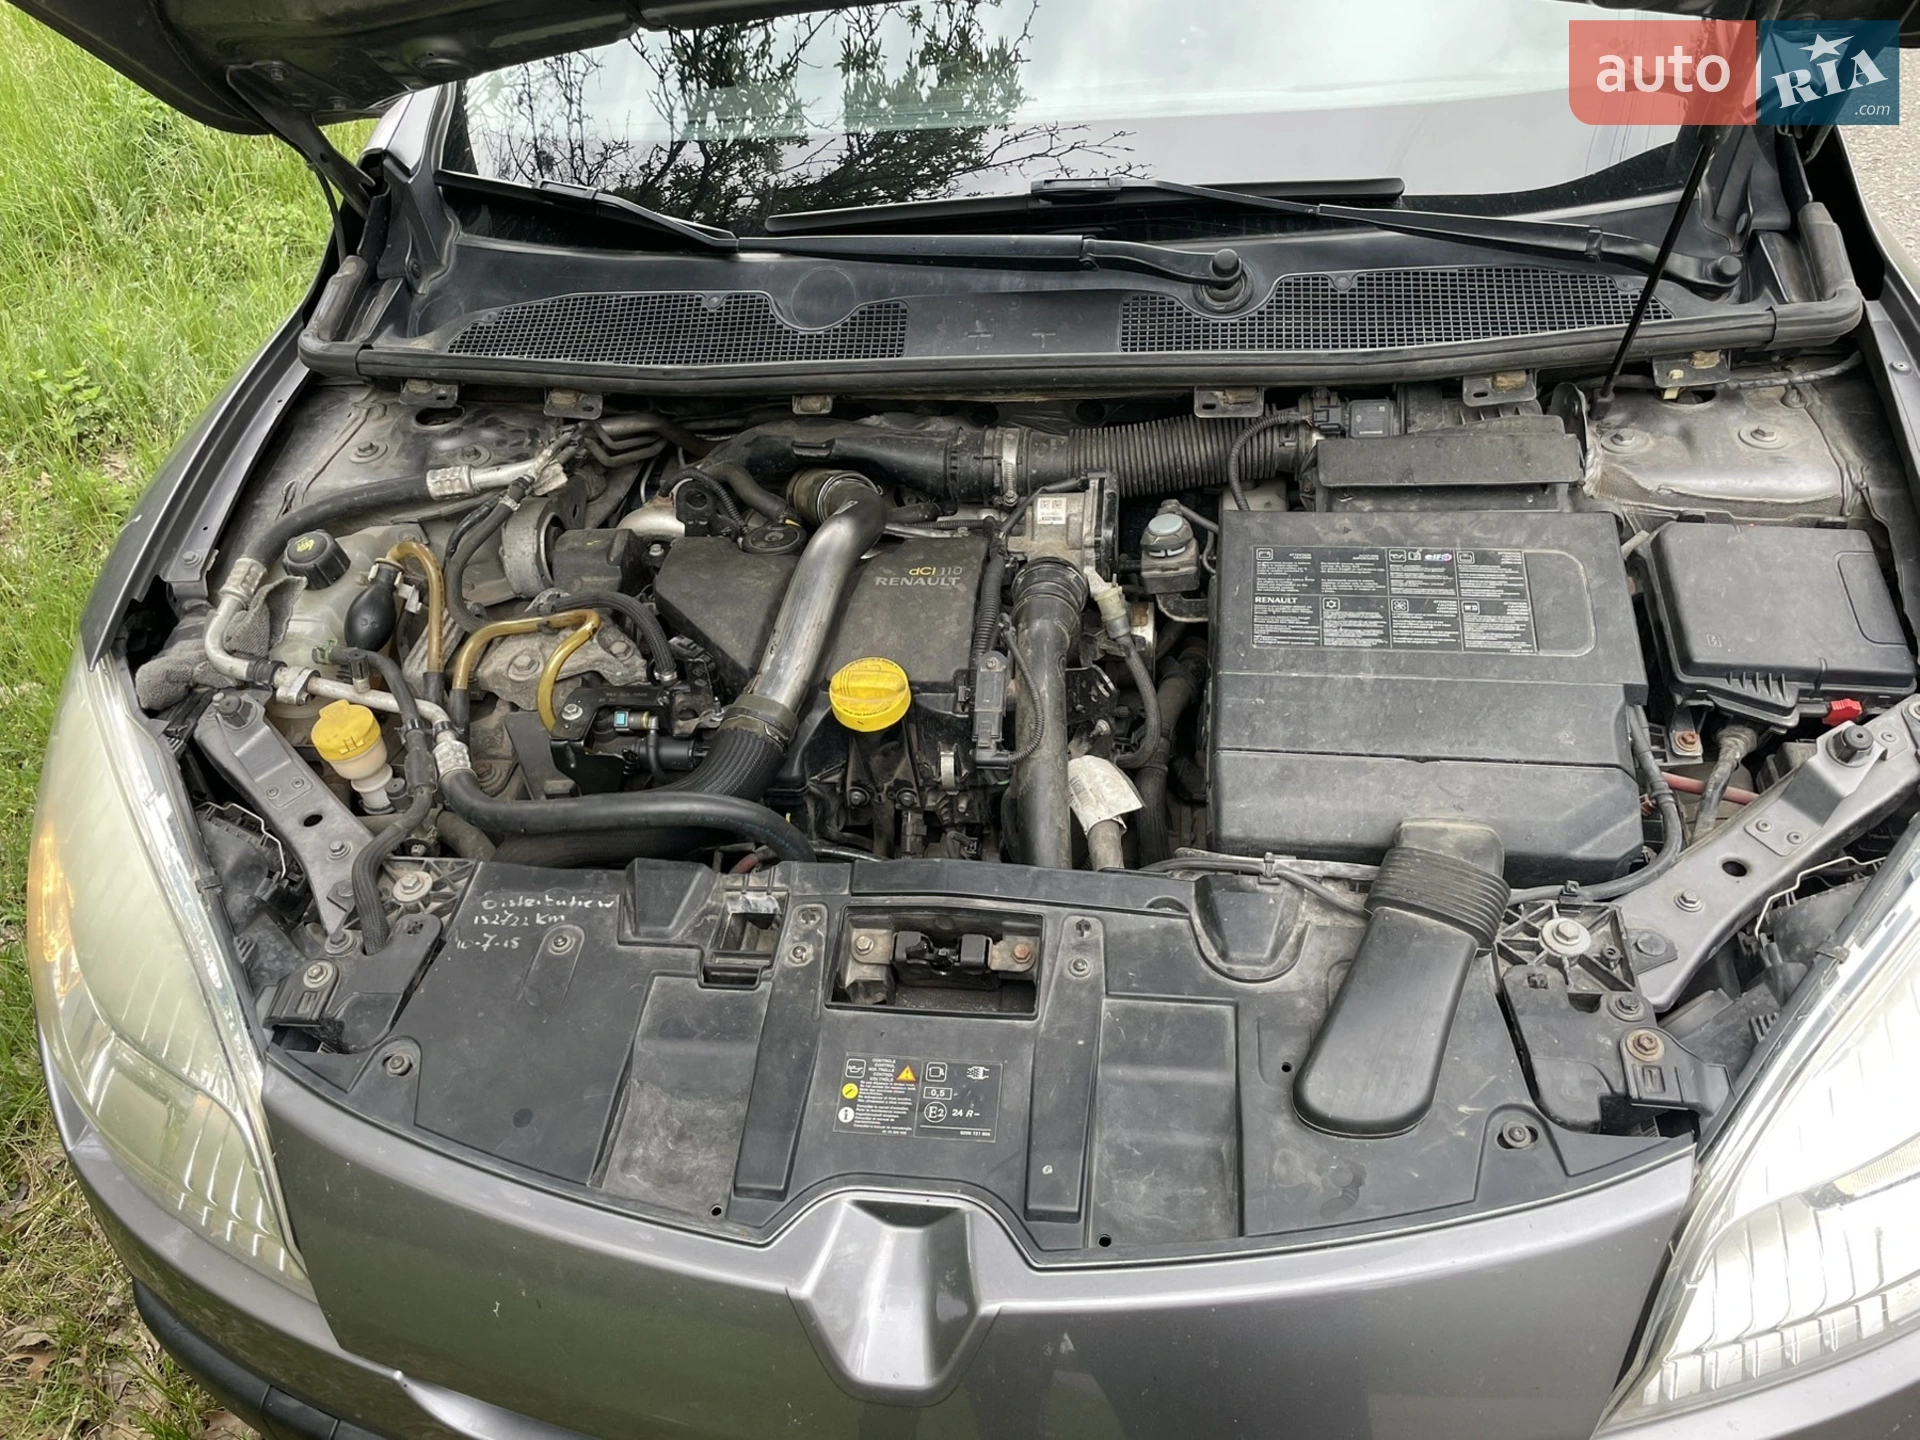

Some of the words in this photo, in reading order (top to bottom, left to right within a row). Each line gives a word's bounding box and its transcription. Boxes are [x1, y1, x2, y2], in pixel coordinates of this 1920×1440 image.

[875, 577, 960, 587] RENAULT
[1255, 596, 1298, 604] RENAULT
[474, 910, 529, 926] 152722
[930, 1089, 946, 1098] 0,5
[928, 1106, 945, 1119] E2
[952, 1109, 963, 1117] 24
